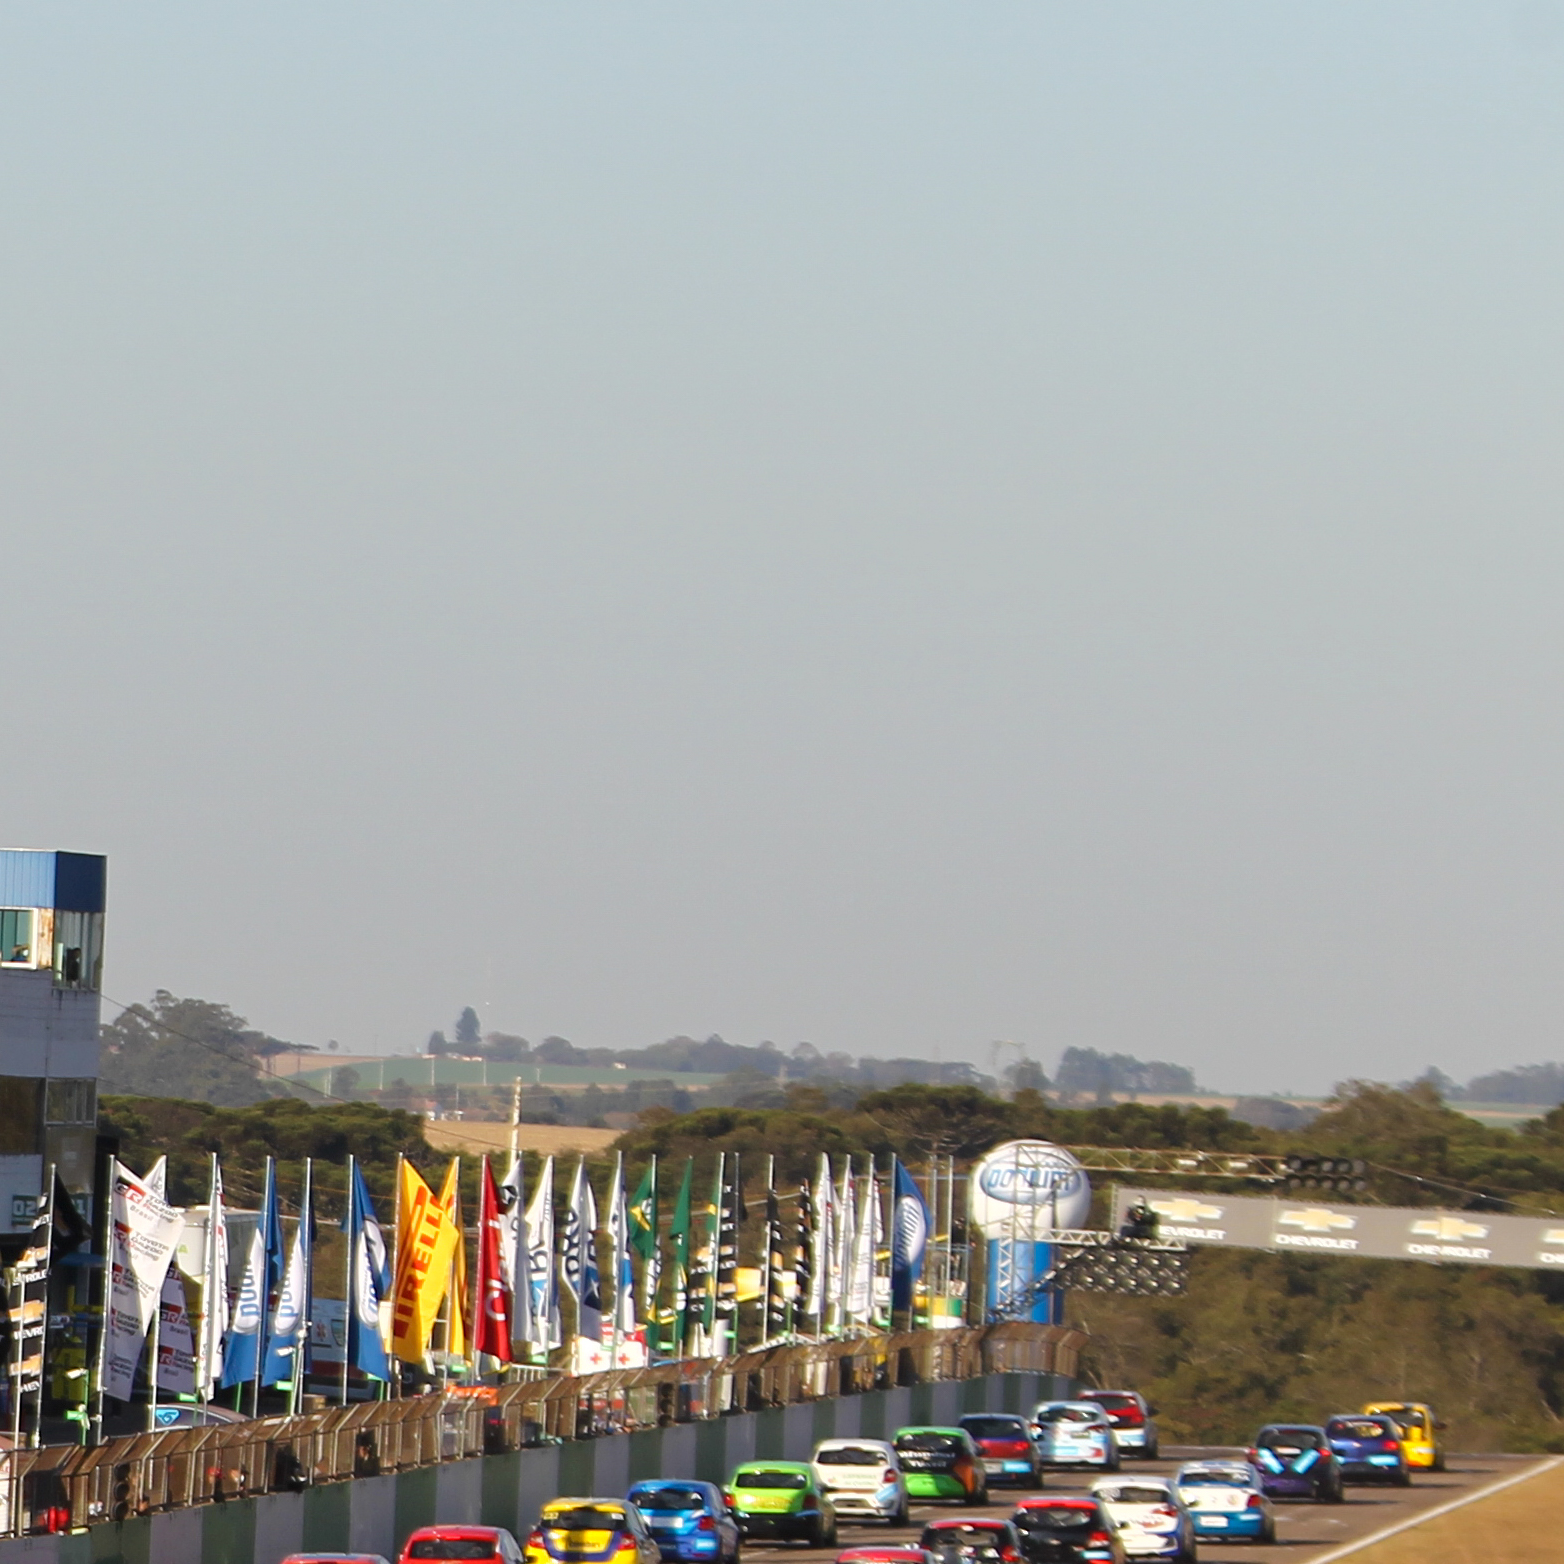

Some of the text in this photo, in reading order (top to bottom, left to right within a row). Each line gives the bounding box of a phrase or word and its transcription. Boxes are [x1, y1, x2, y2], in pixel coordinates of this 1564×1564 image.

[13, 1204, 38, 1219] 02
[1158, 1224, 1226, 1240] EVROLET
[1275, 1233, 1359, 1250] CHEVROLET
[1406, 1242, 1492, 1260] CHEVROLET
